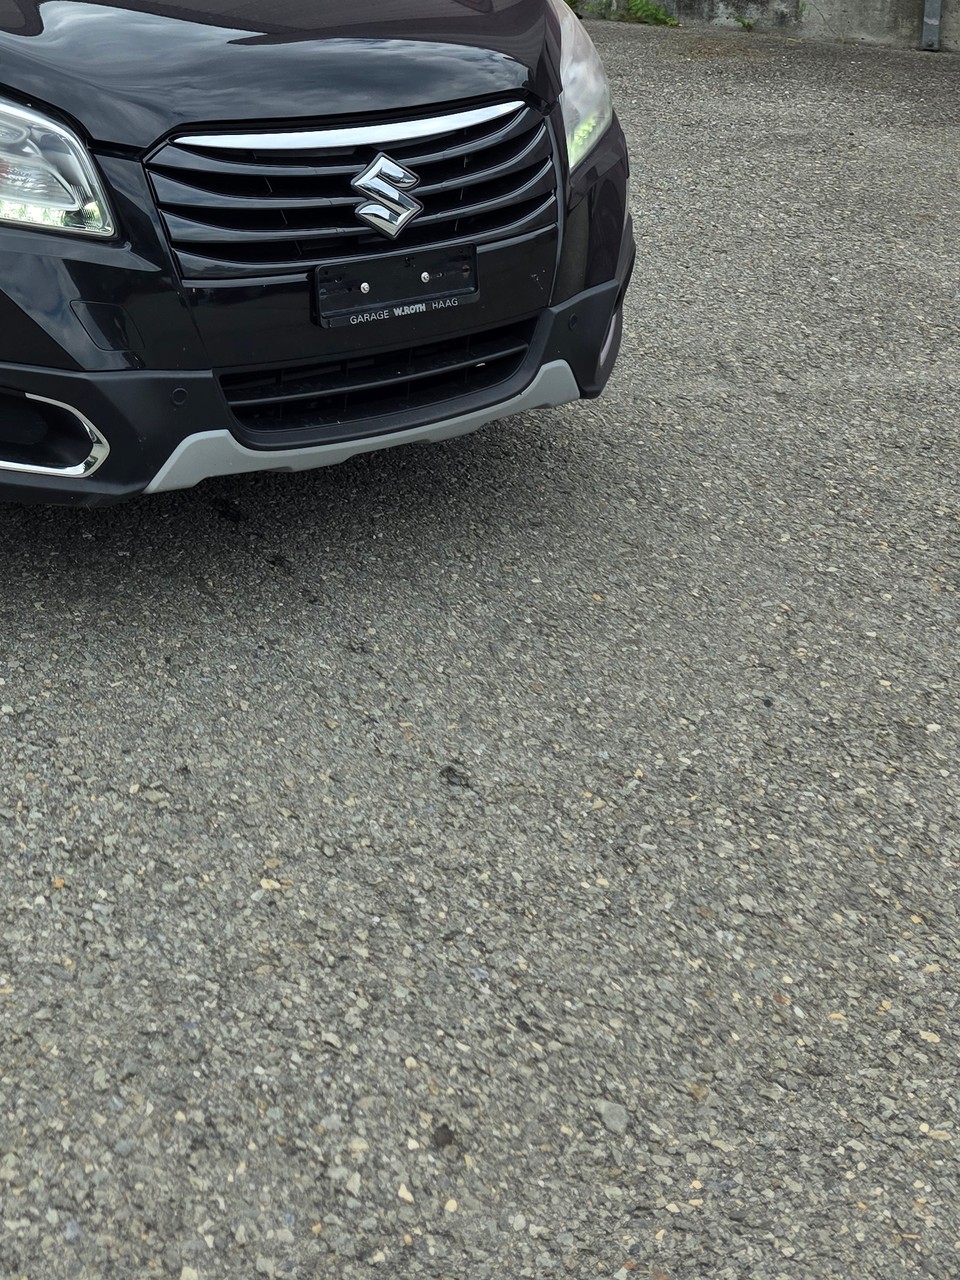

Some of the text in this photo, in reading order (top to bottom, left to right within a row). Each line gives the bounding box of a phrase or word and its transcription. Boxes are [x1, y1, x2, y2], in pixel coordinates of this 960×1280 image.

[349, 298, 459, 325] GARAGE W.ROTH HAAG
